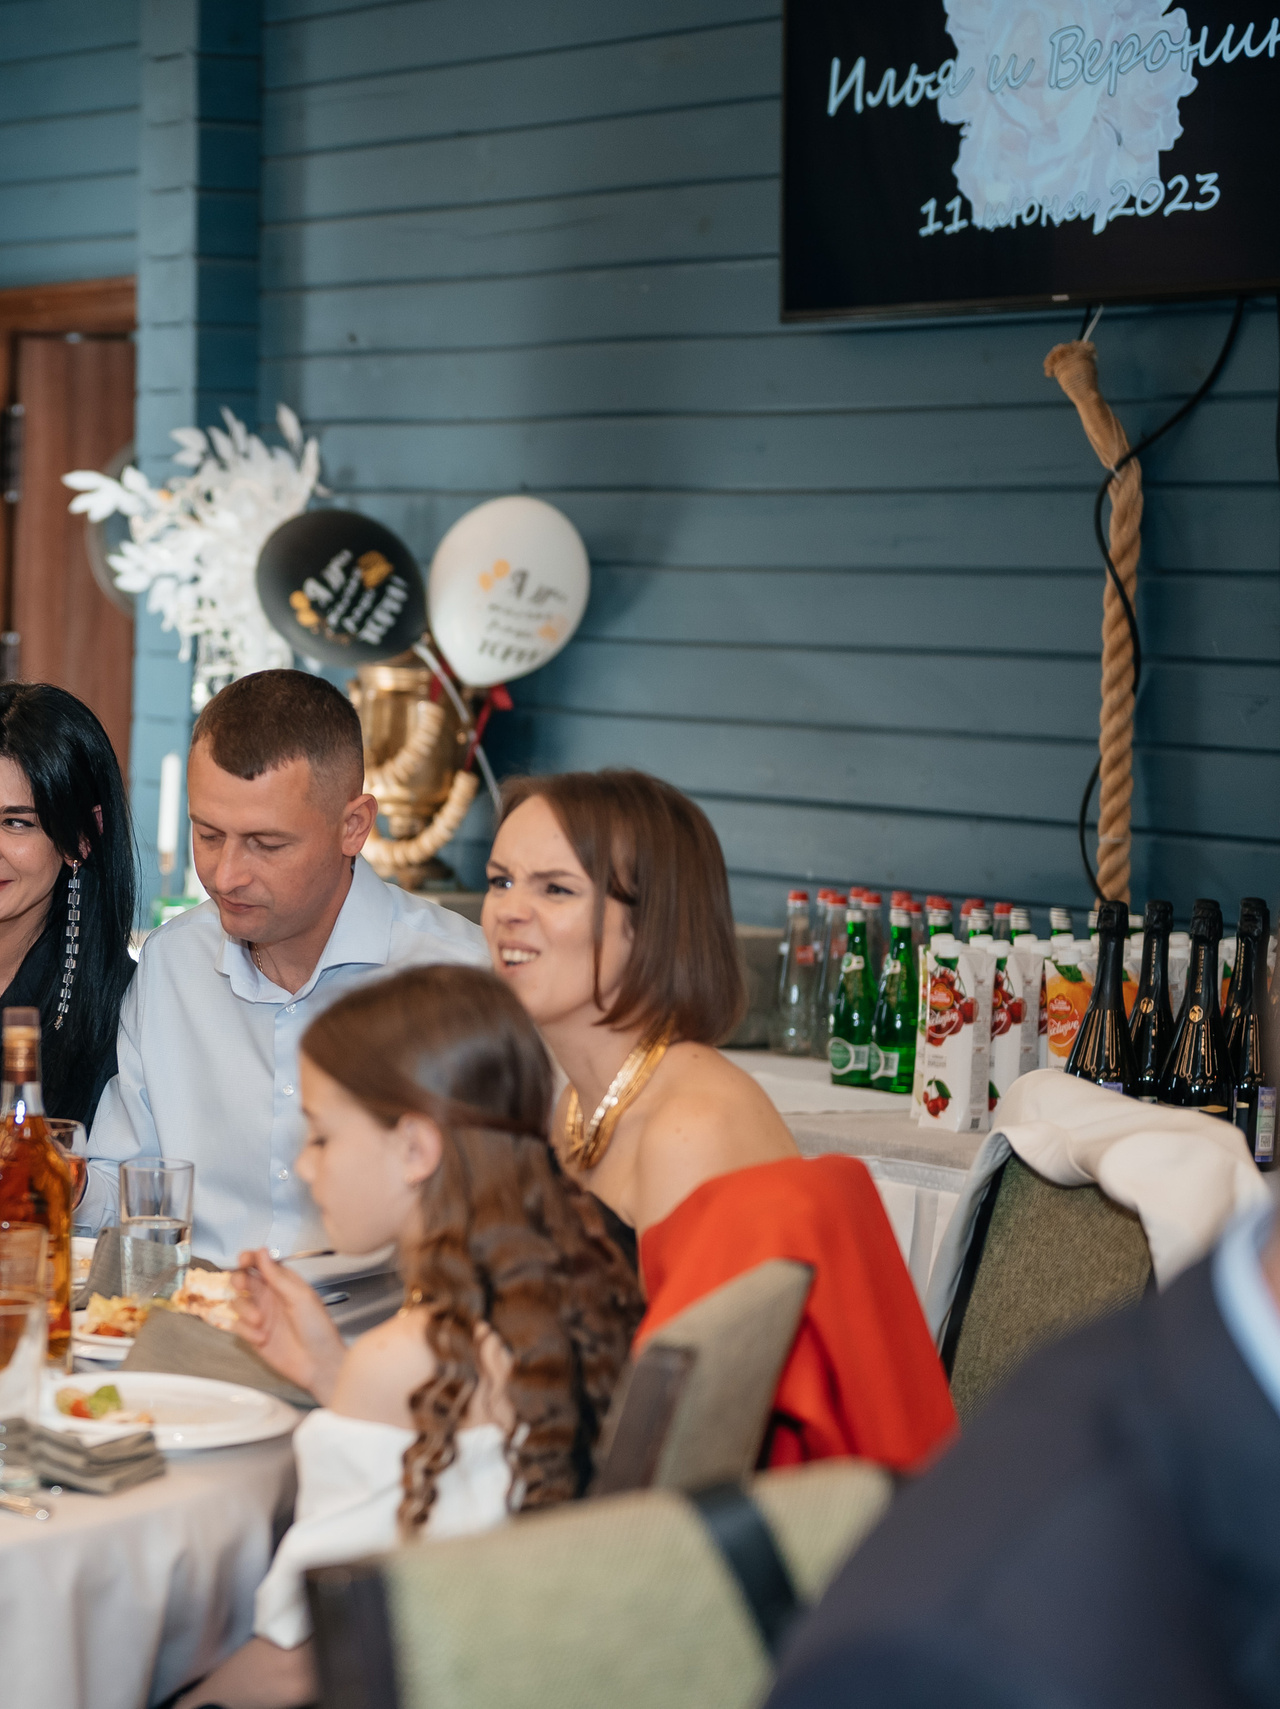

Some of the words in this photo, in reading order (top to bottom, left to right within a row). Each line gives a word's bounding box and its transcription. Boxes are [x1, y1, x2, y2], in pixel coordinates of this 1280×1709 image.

[827, 55, 975, 117] Илья
[986, 52, 1036, 95] и
[919, 195, 969, 237] 11
[981, 189, 1101, 231] июня
[1107, 172, 1221, 222] 2023
